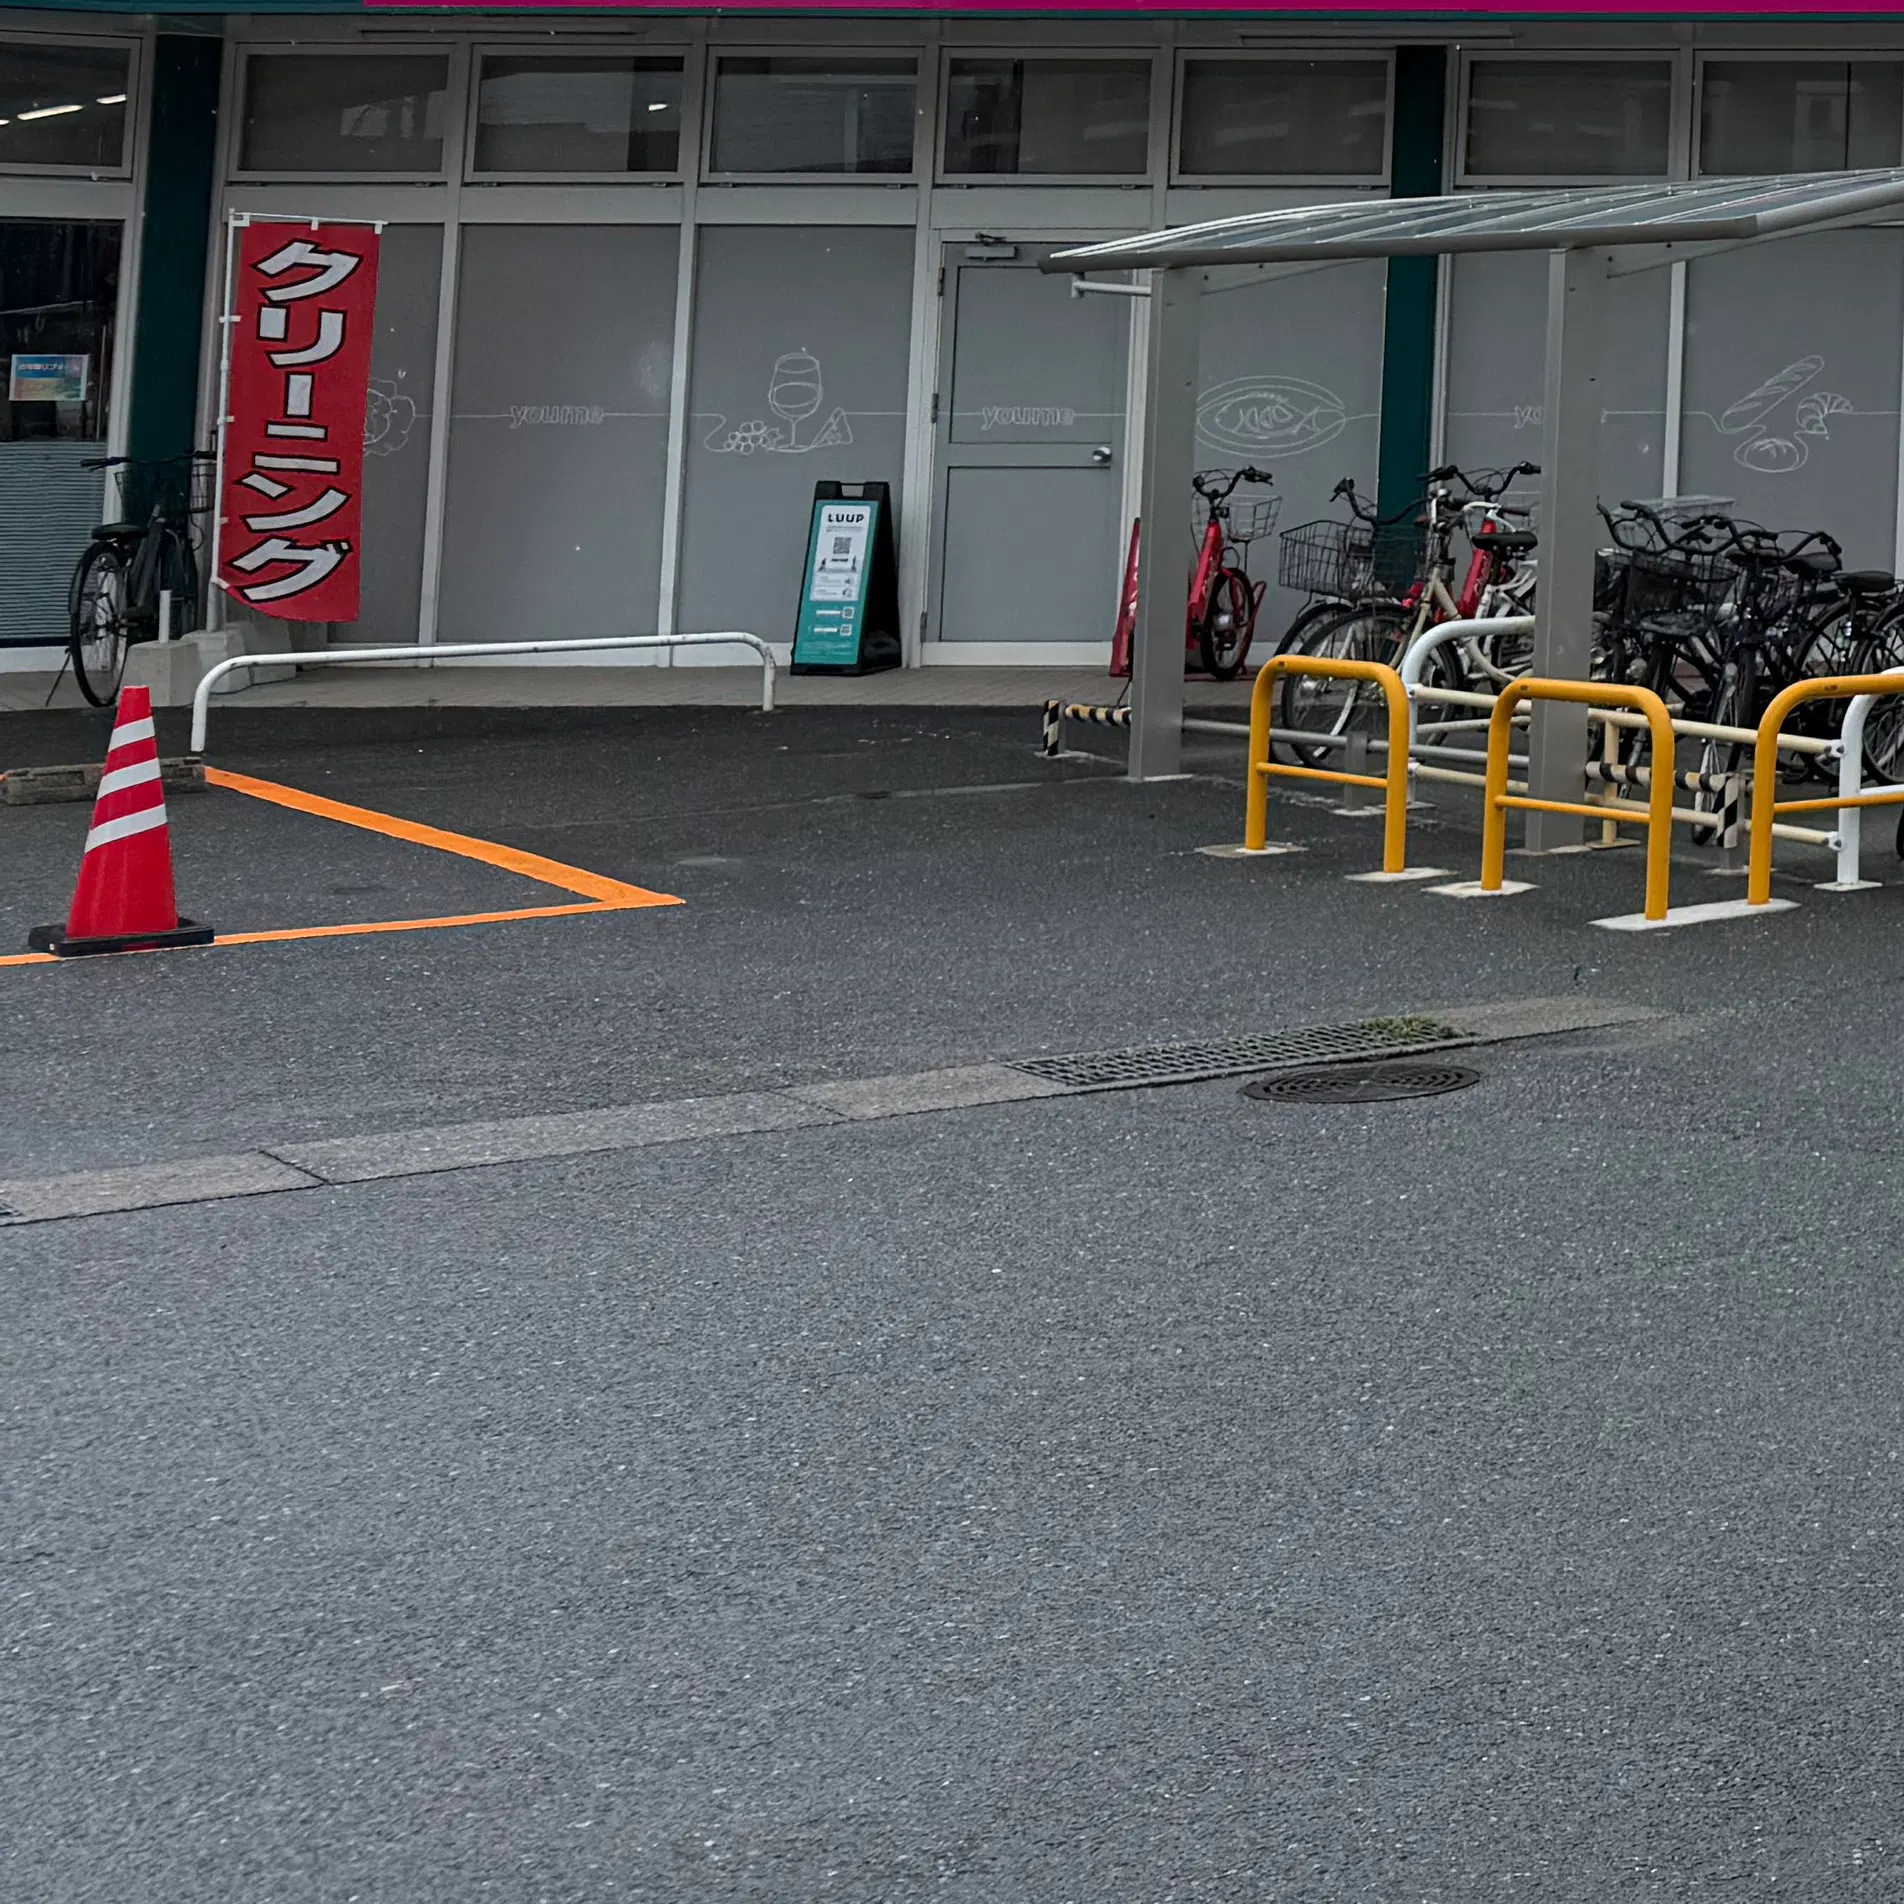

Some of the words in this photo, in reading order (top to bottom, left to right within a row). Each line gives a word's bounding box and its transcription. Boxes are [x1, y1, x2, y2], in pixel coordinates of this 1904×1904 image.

[233, 238, 362, 603] クリーニング
[980, 405, 1075, 431] youme
[827, 513, 865, 523] LUUP
